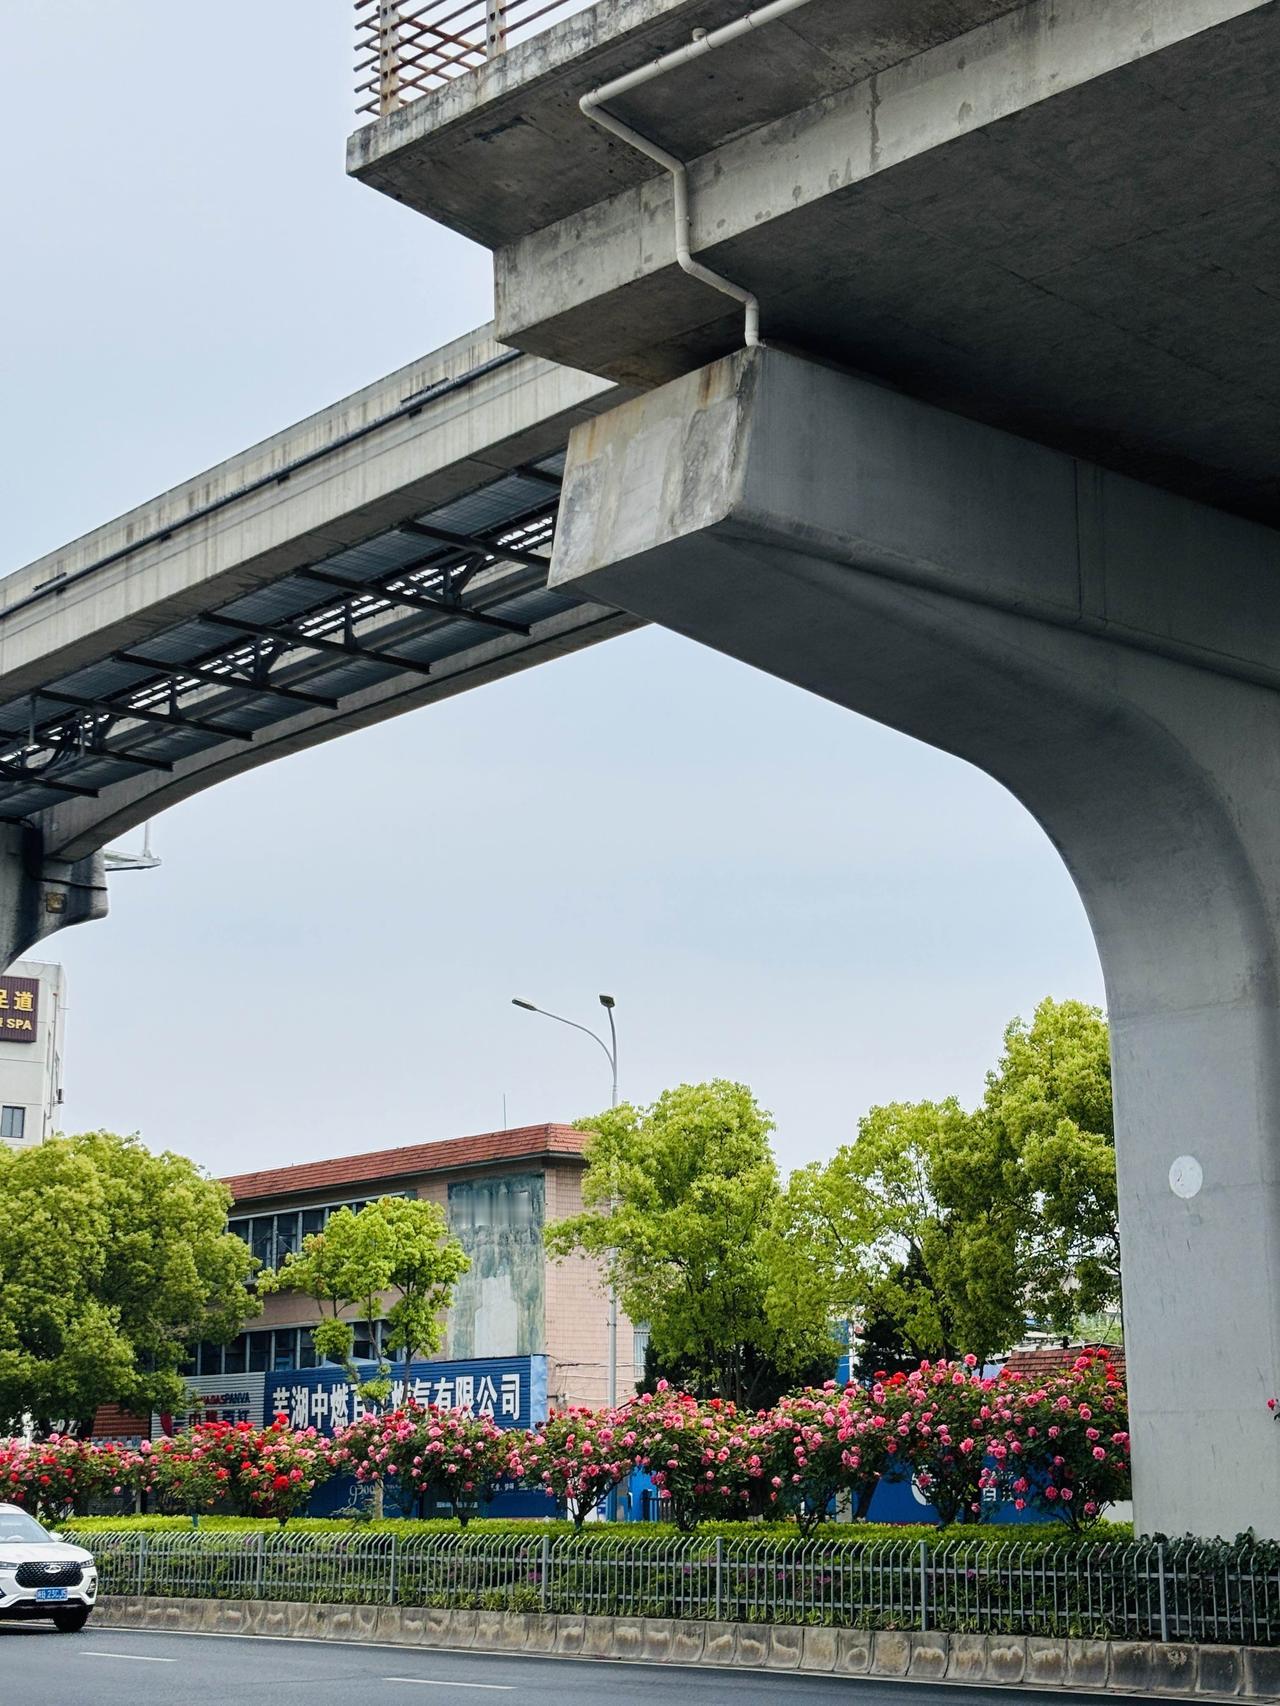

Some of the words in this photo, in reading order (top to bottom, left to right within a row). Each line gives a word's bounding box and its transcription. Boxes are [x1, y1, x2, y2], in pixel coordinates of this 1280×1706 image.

[7, 1019, 31, 1030] SPA
[272, 1373, 520, 1429] 芜湖中燃百气有限公司
